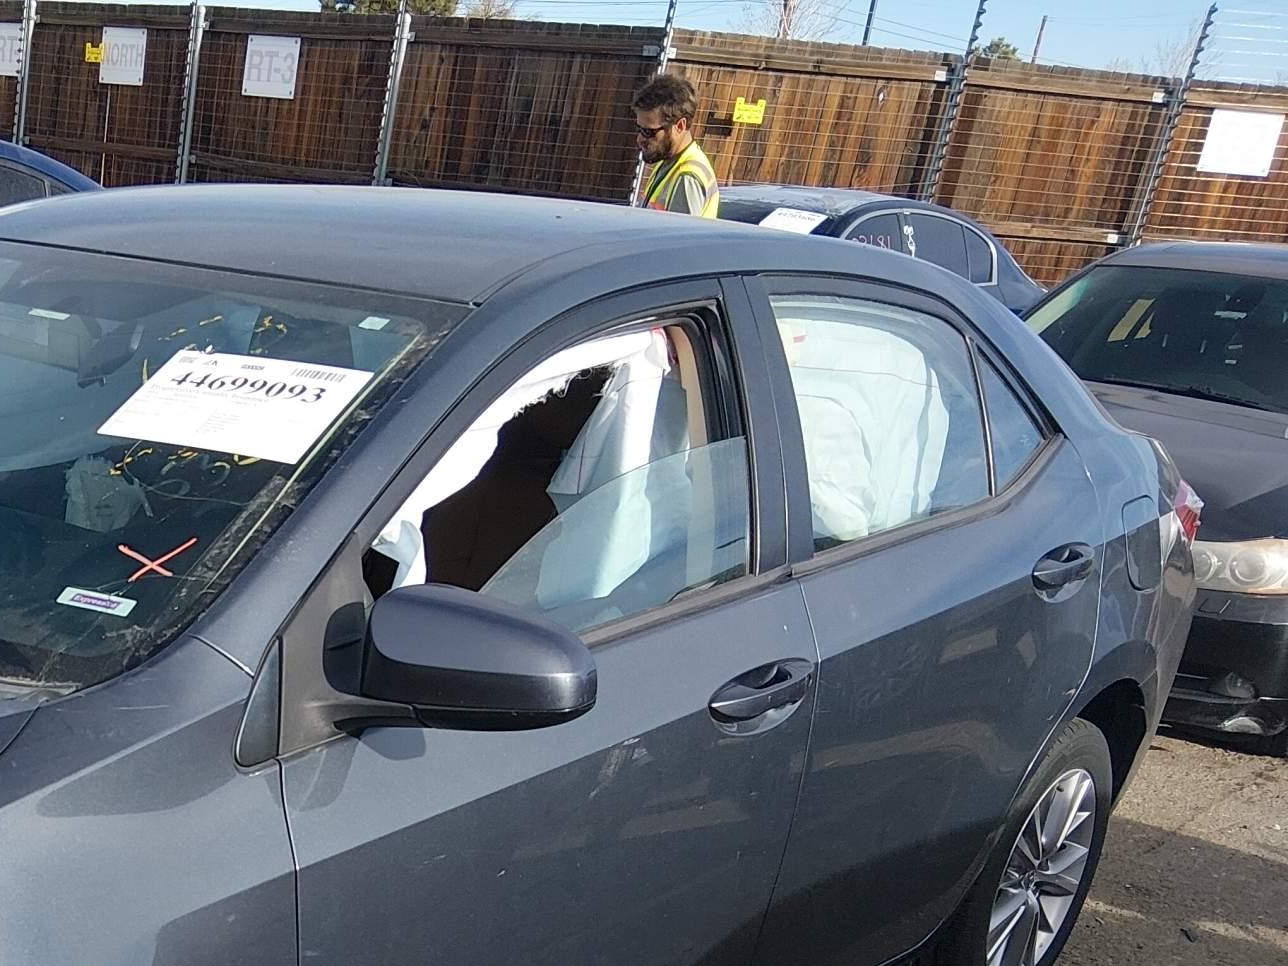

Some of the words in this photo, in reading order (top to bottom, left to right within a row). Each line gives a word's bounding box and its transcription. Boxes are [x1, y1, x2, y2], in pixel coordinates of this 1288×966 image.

[103, 42, 144, 67] NORTH
[246, 49, 295, 84] RT-3
[171, 371, 327, 403] 44699093
